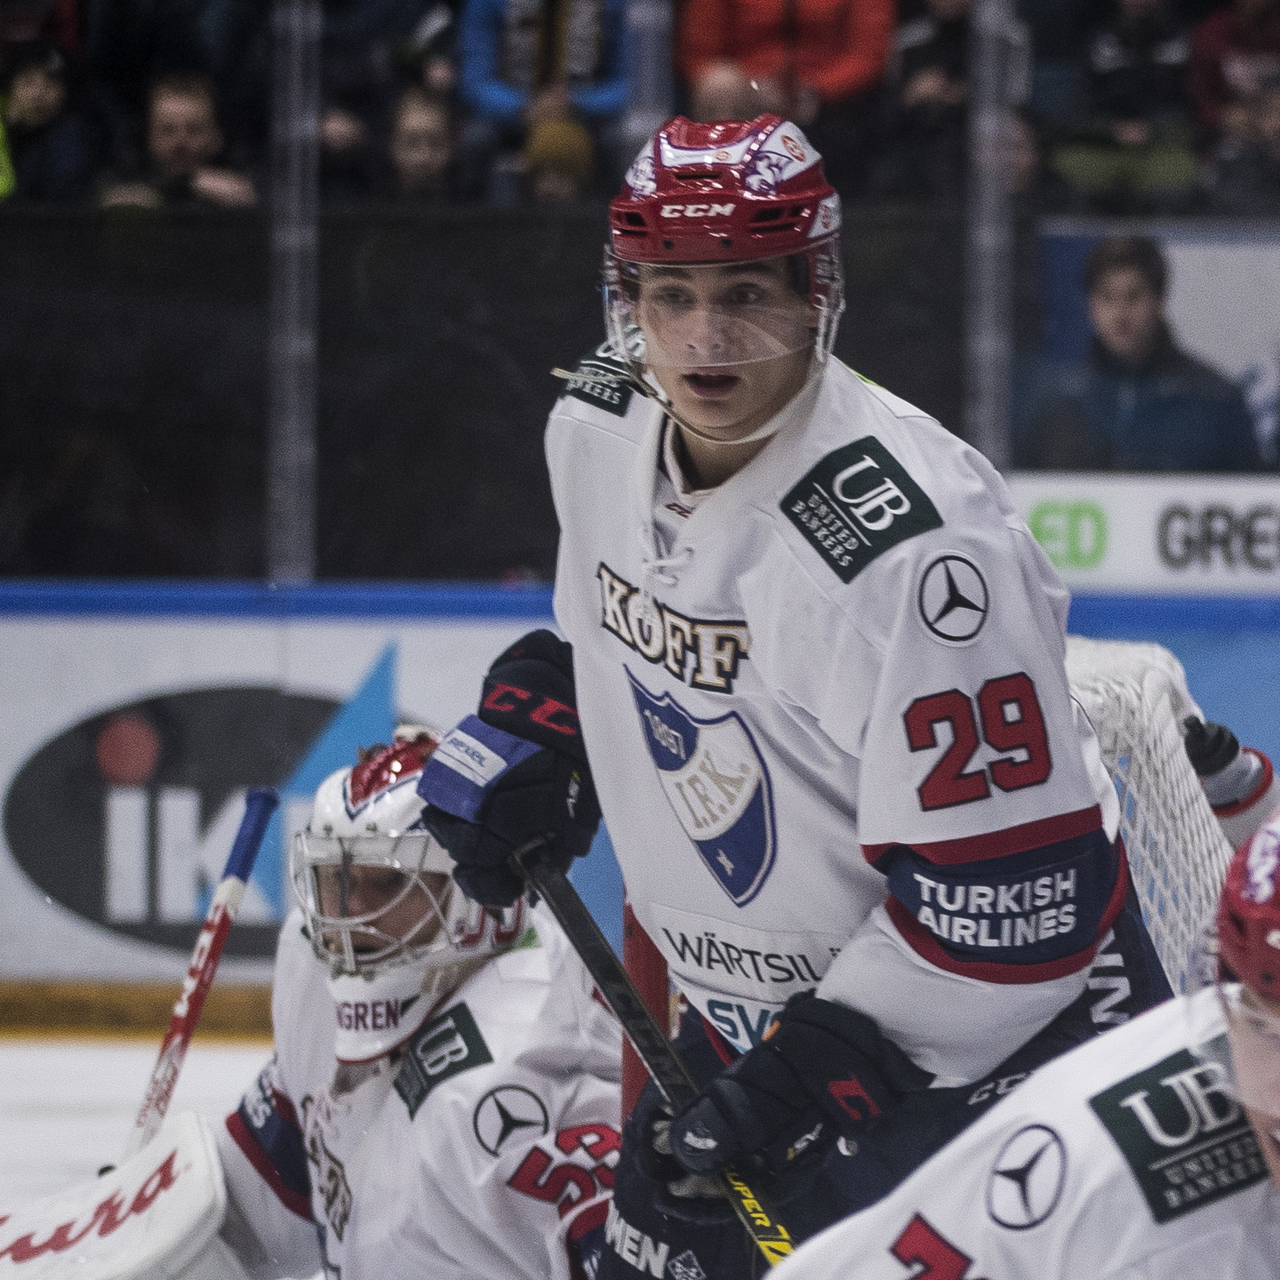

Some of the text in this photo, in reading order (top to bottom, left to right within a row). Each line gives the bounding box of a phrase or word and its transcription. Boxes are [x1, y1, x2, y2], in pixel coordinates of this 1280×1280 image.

[659, 203, 737, 218] CCM
[806, 493, 859, 551] UNITED
[831, 454, 912, 531] UB
[791, 499, 854, 567] BANKERS
[597, 561, 751, 694] KOFF
[903, 670, 1054, 812] 29
[912, 868, 1078, 914] TURKISH
[917, 903, 1078, 948] AIRLINES
[416, 1015, 469, 1077] UB
[1119, 1060, 1243, 1149] UB
